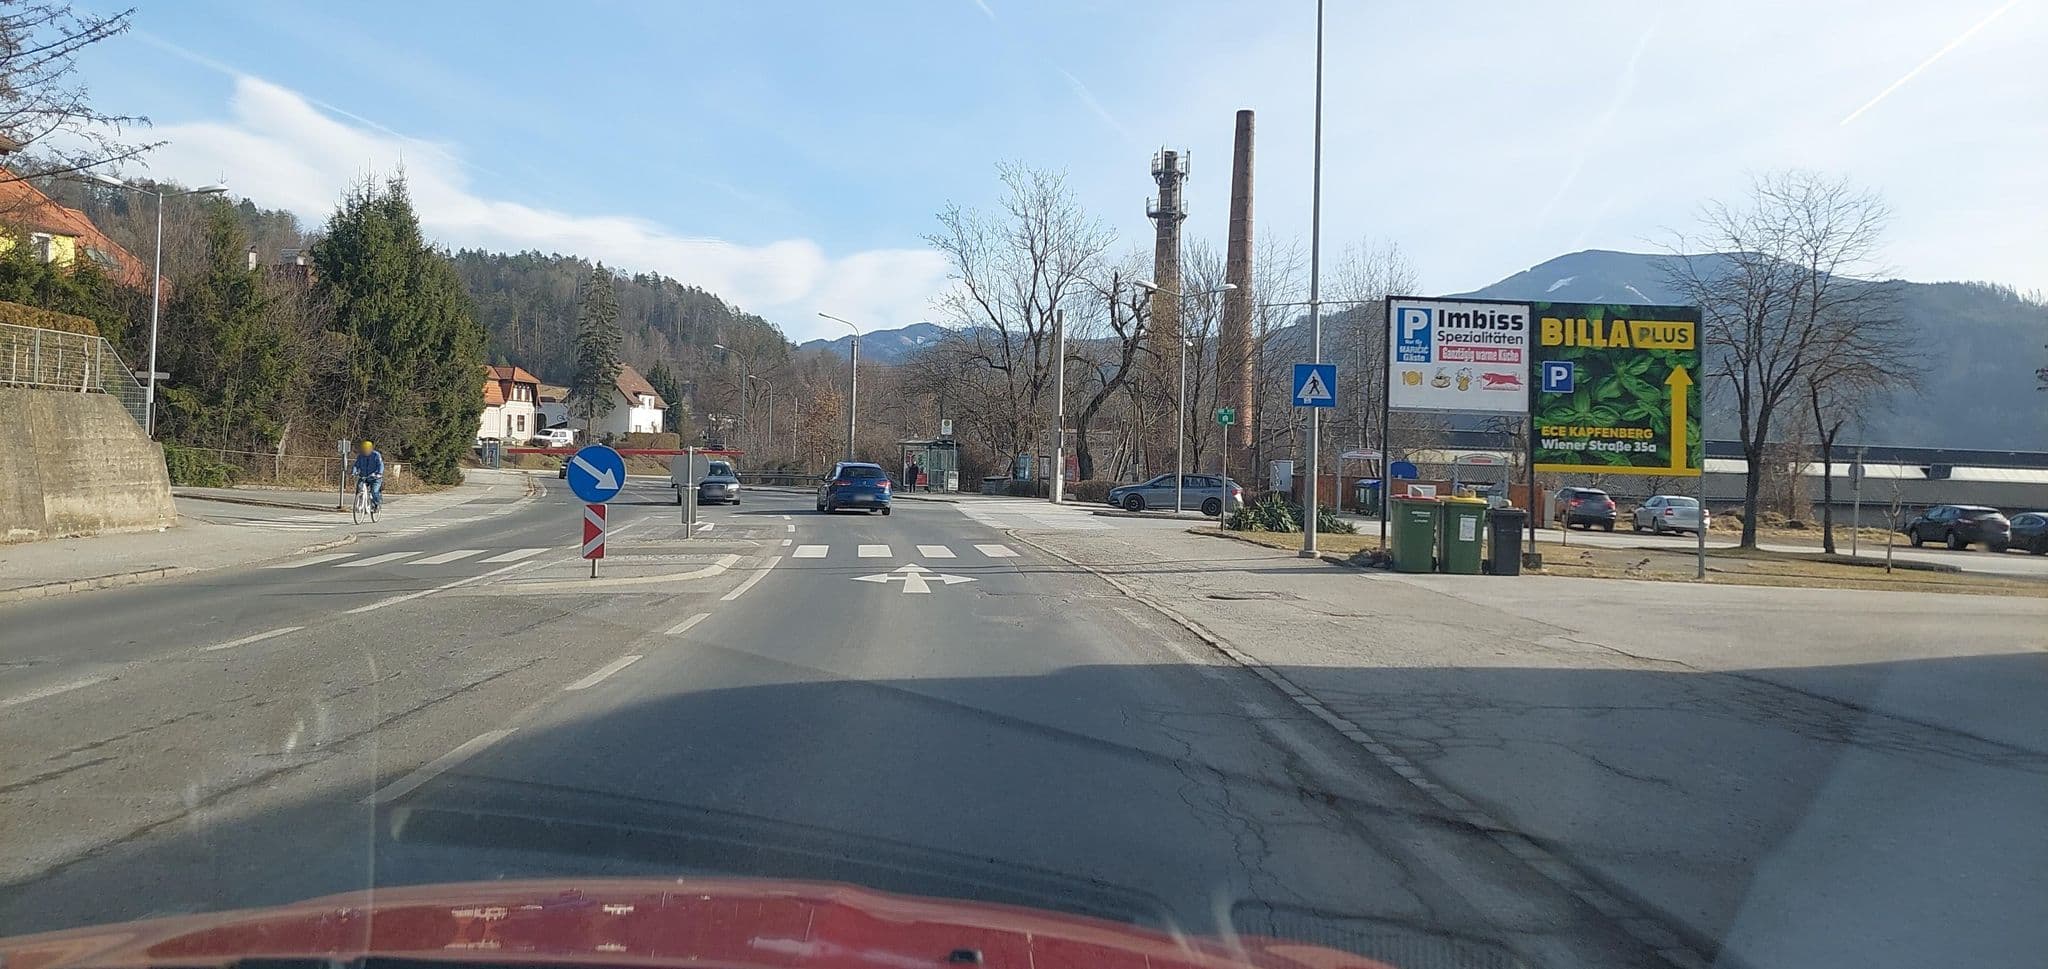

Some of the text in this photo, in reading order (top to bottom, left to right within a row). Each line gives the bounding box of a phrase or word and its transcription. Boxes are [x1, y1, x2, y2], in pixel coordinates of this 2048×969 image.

[1404, 309, 1428, 339] P
[1438, 309, 1523, 331] Imbiss
[1437, 331, 1523, 345] Spezialitäten
[1541, 317, 1689, 348] BILLA PLUS
[1442, 347, 1519, 362] Ganztägig warme Küche
[1550, 366, 1568, 388] P
[1541, 426, 1654, 439] ECE KAPFENBERG
[1541, 438, 1657, 453] Wiener Straße 35a
